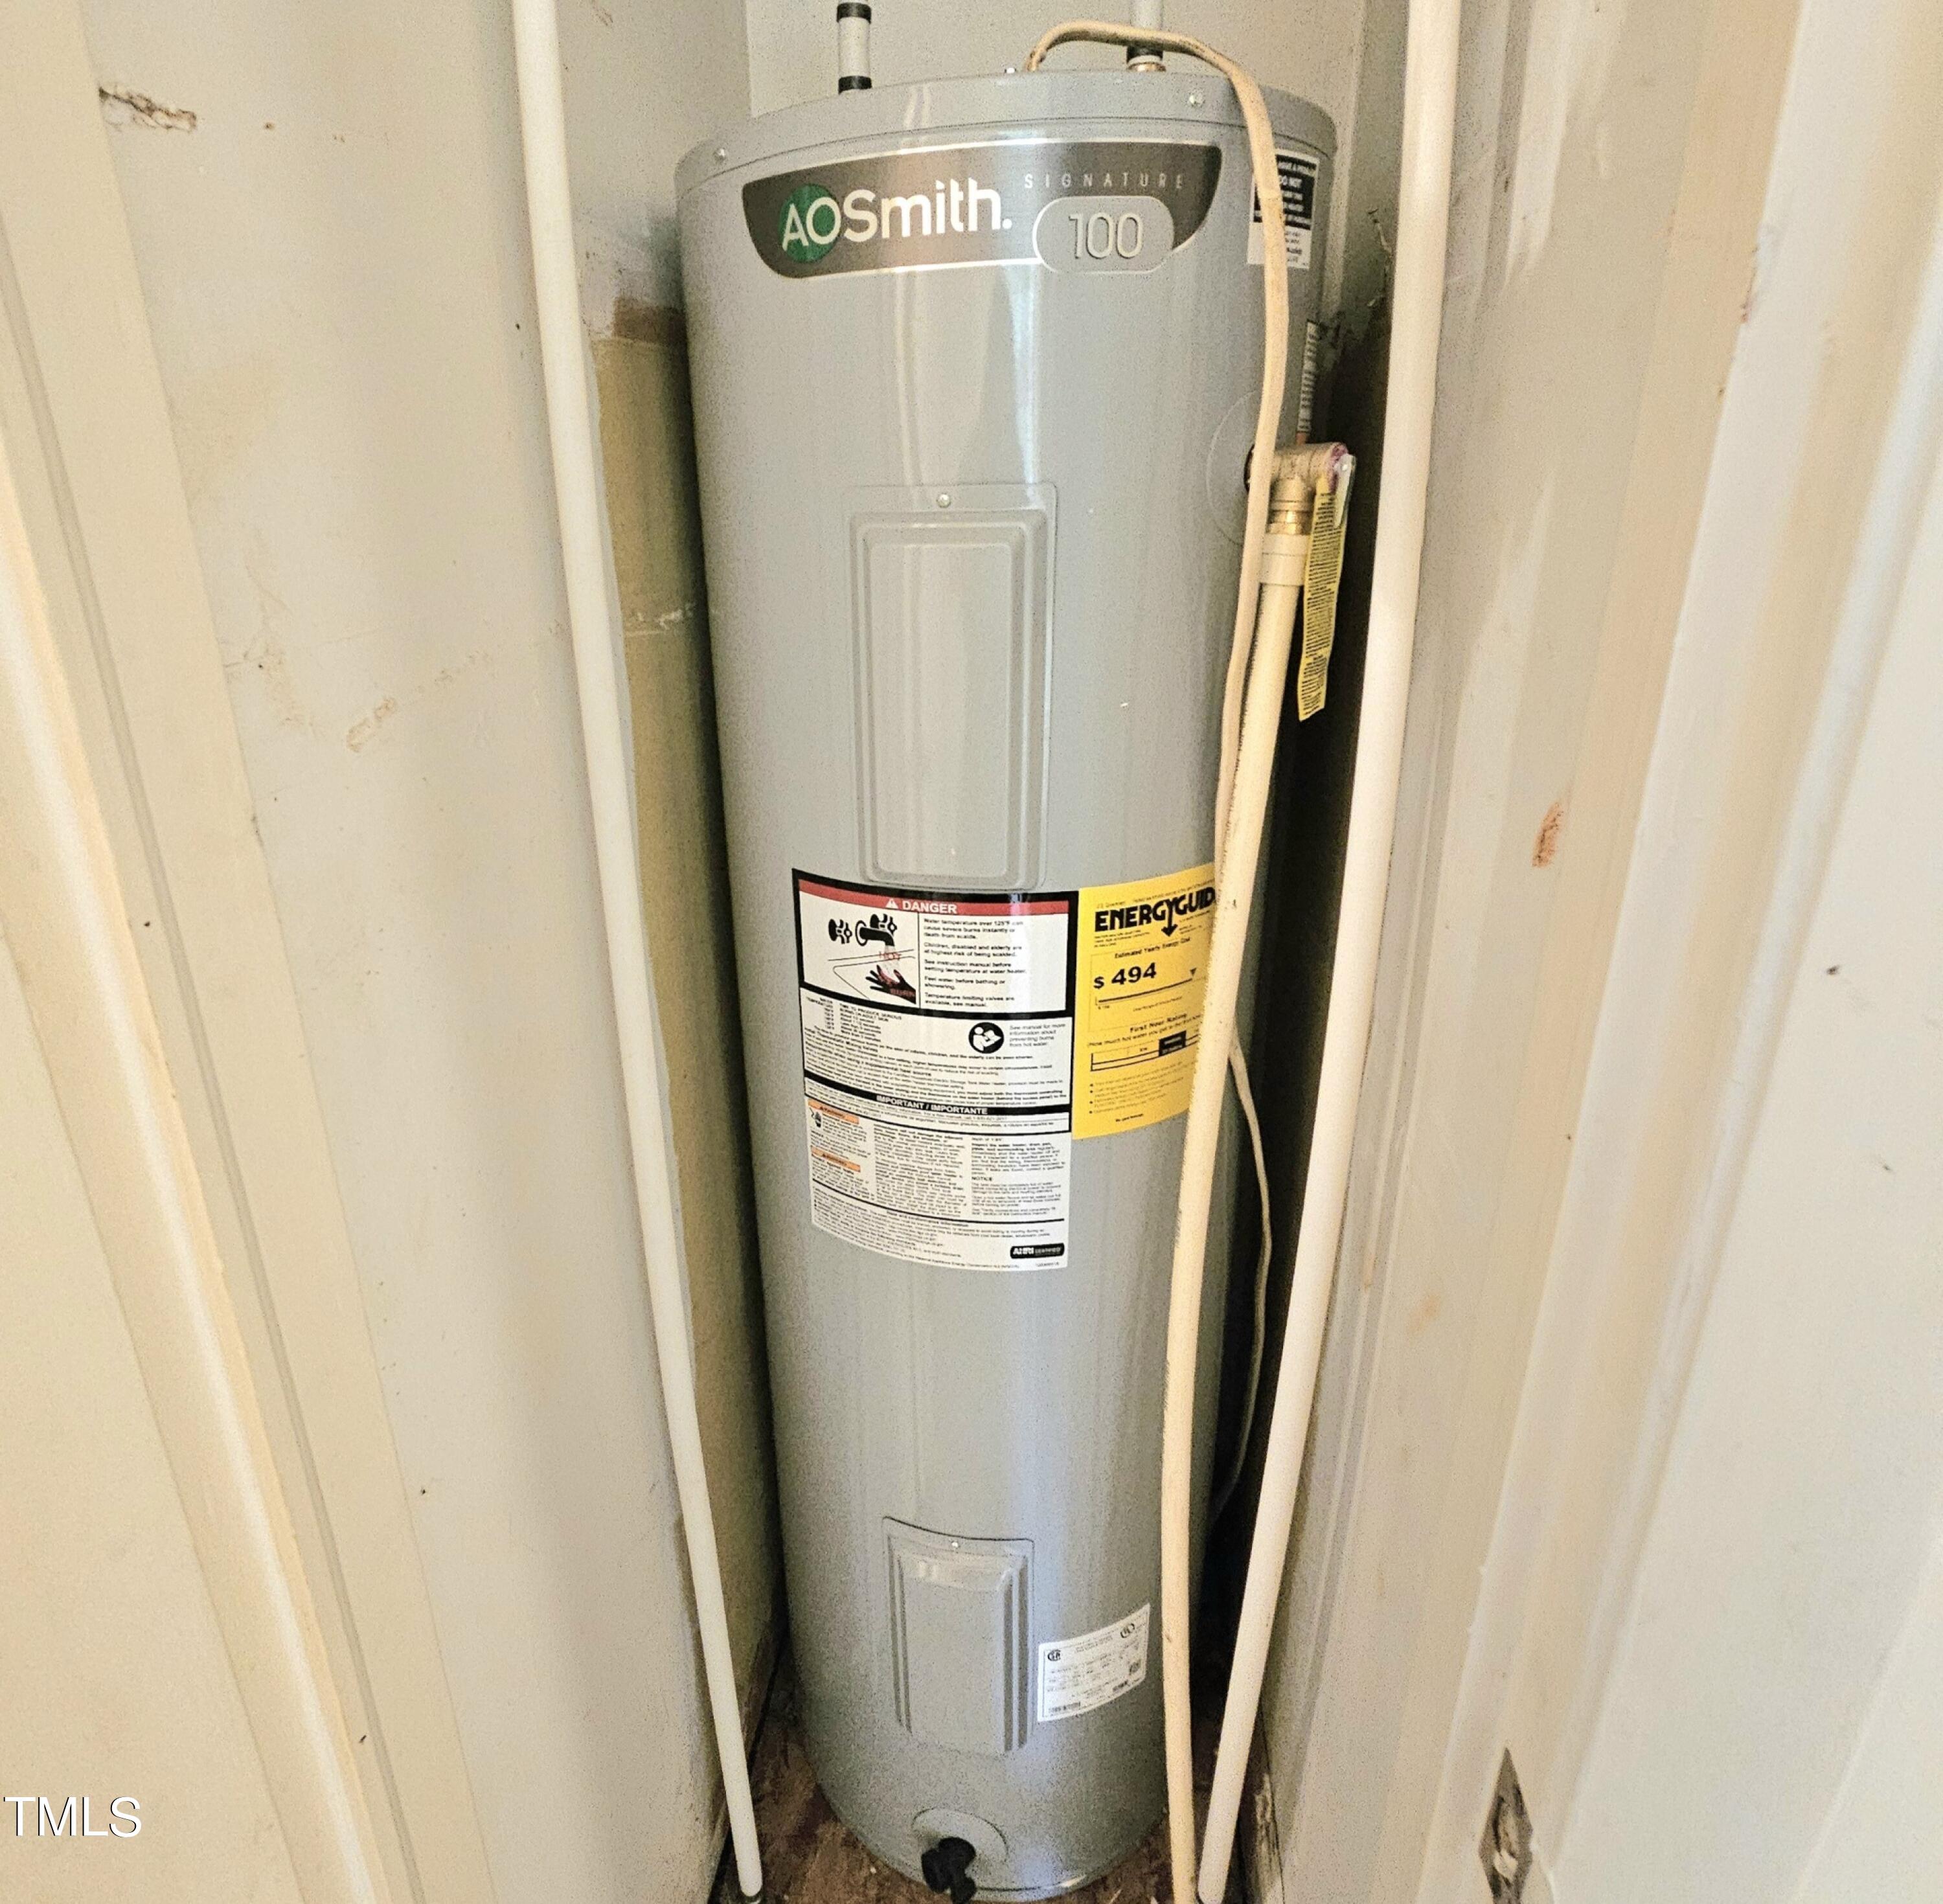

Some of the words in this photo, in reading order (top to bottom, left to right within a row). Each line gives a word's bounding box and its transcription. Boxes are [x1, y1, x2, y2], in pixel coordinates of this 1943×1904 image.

[1025, 173, 1184, 189] SIGNATURE
[1069, 212, 1143, 259] 100
[902, 900, 957, 914] DANGER
[1095, 887, 1216, 936] ENERGYGUID
[1115, 949, 1142, 958] Estimated
[1093, 976, 1104, 990] $
[1111, 962, 1157, 985] 494
[1130, 1024, 1146, 1033] First
[876, 1095, 925, 1109] IMPORTANT
[931, 1104, 988, 1115] IMPORTANTE
